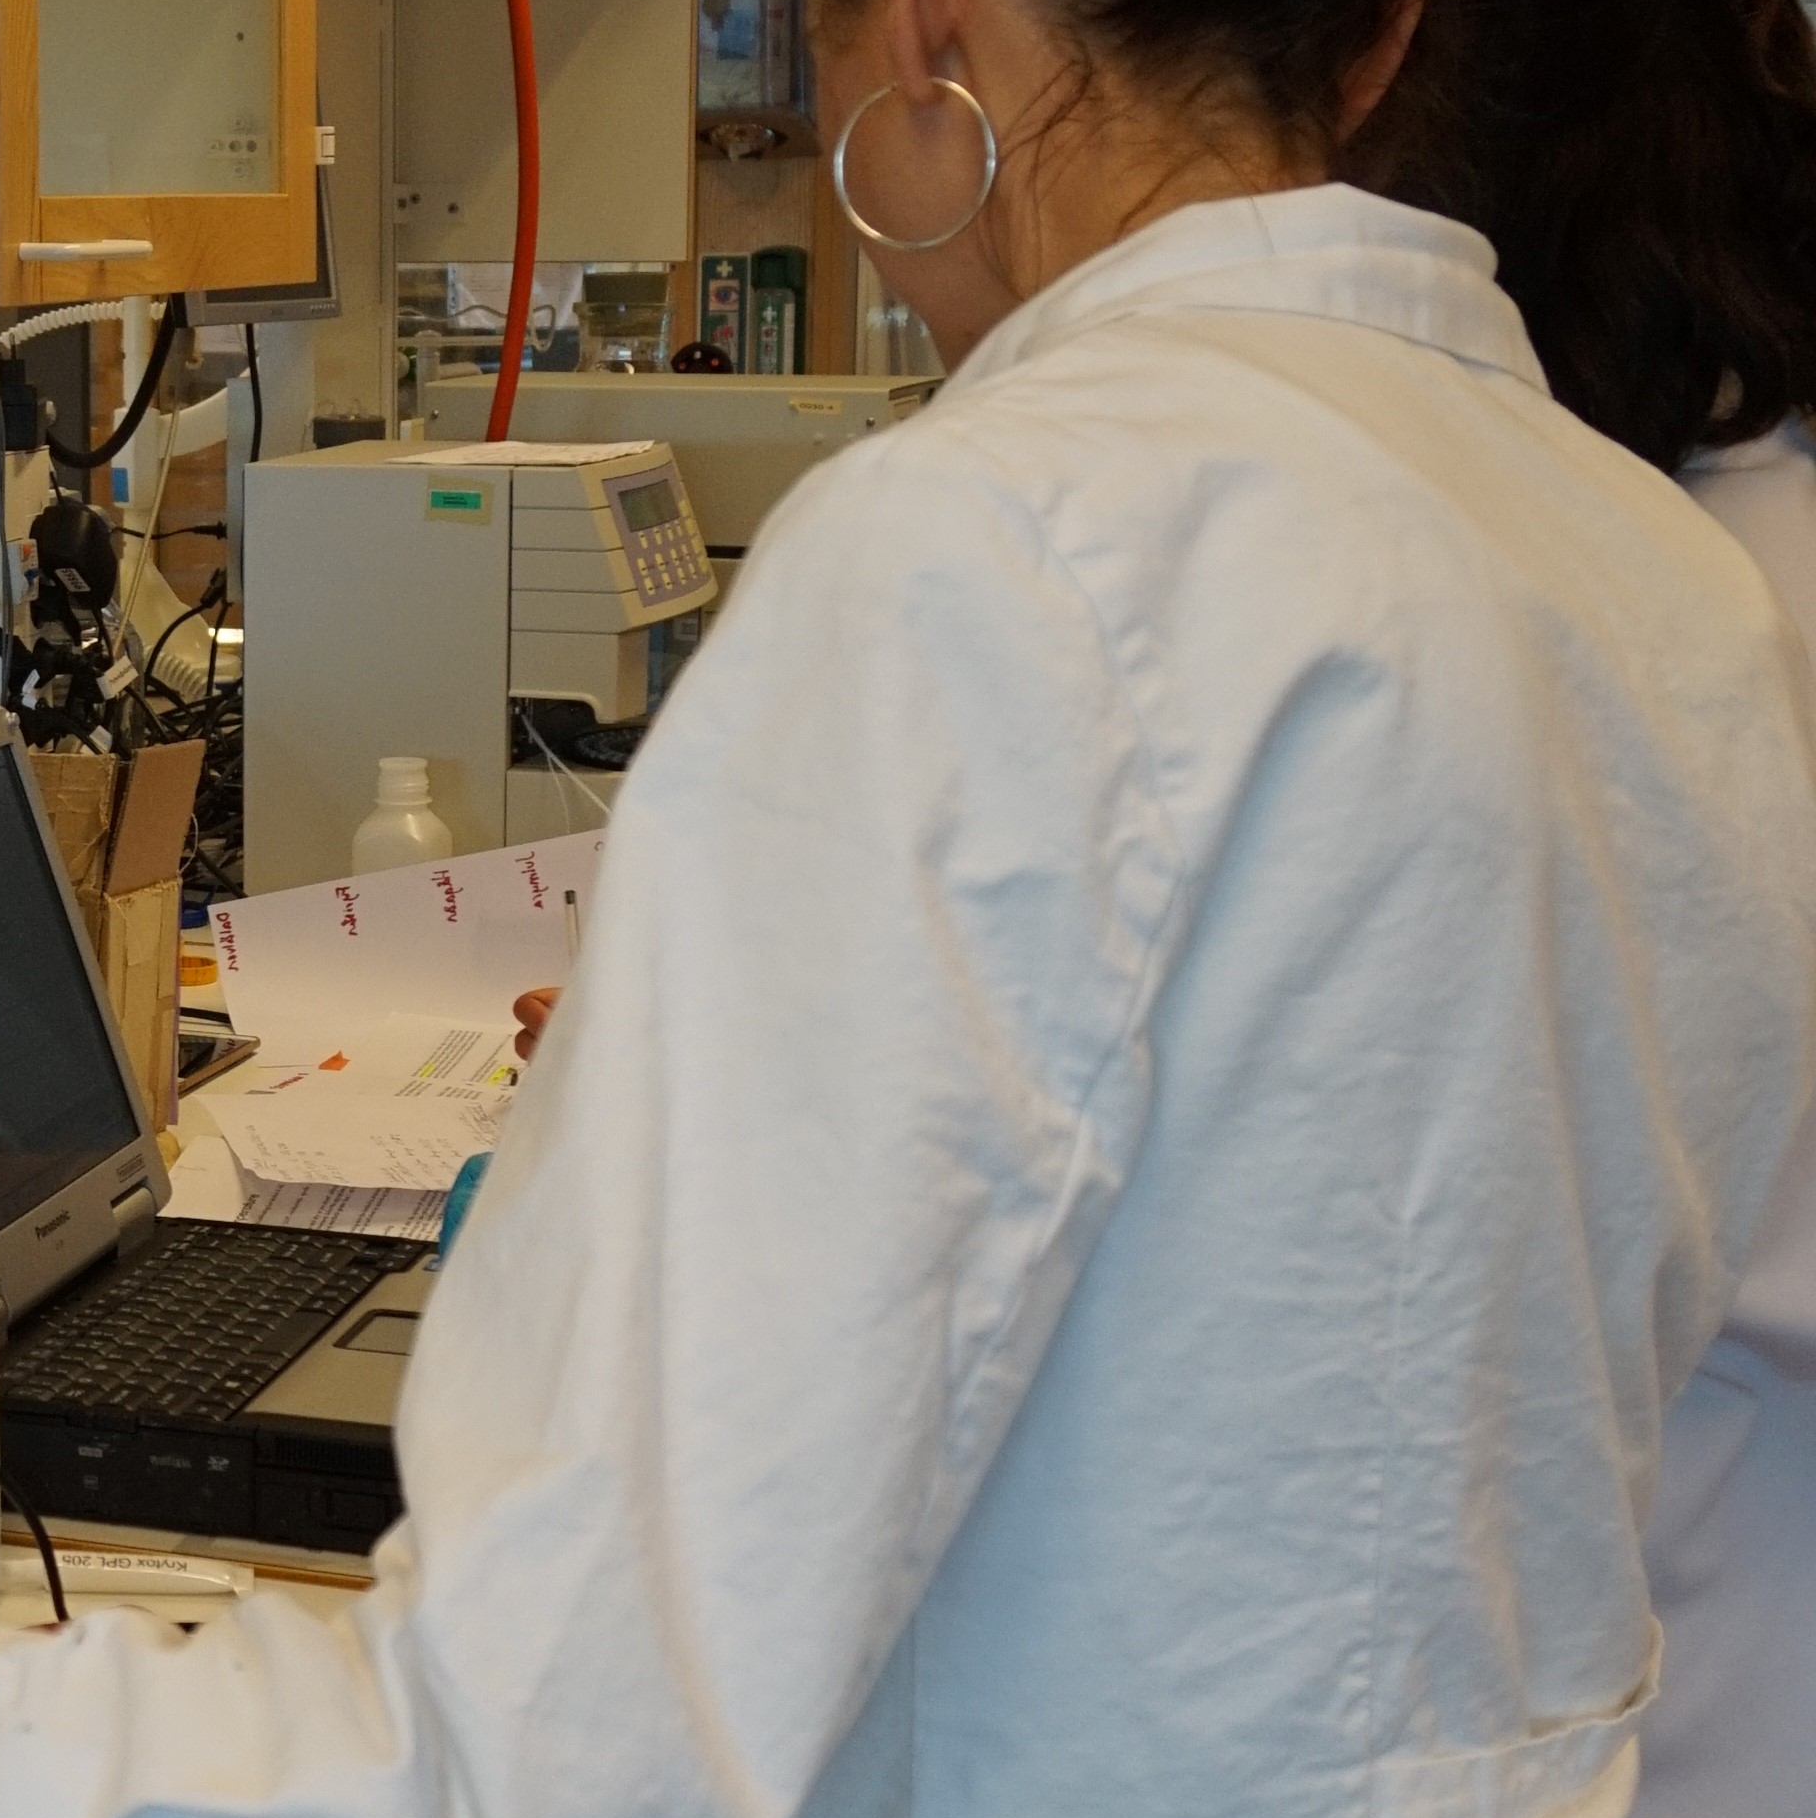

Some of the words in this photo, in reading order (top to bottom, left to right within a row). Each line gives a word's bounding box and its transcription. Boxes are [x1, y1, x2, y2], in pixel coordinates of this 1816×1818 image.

[35, 1209, 71, 1241] Panasonic
[62, 1554, 93, 1567] 205
[98, 1556, 133, 1570] GPL
[136, 1558, 188, 1573] Krytox
